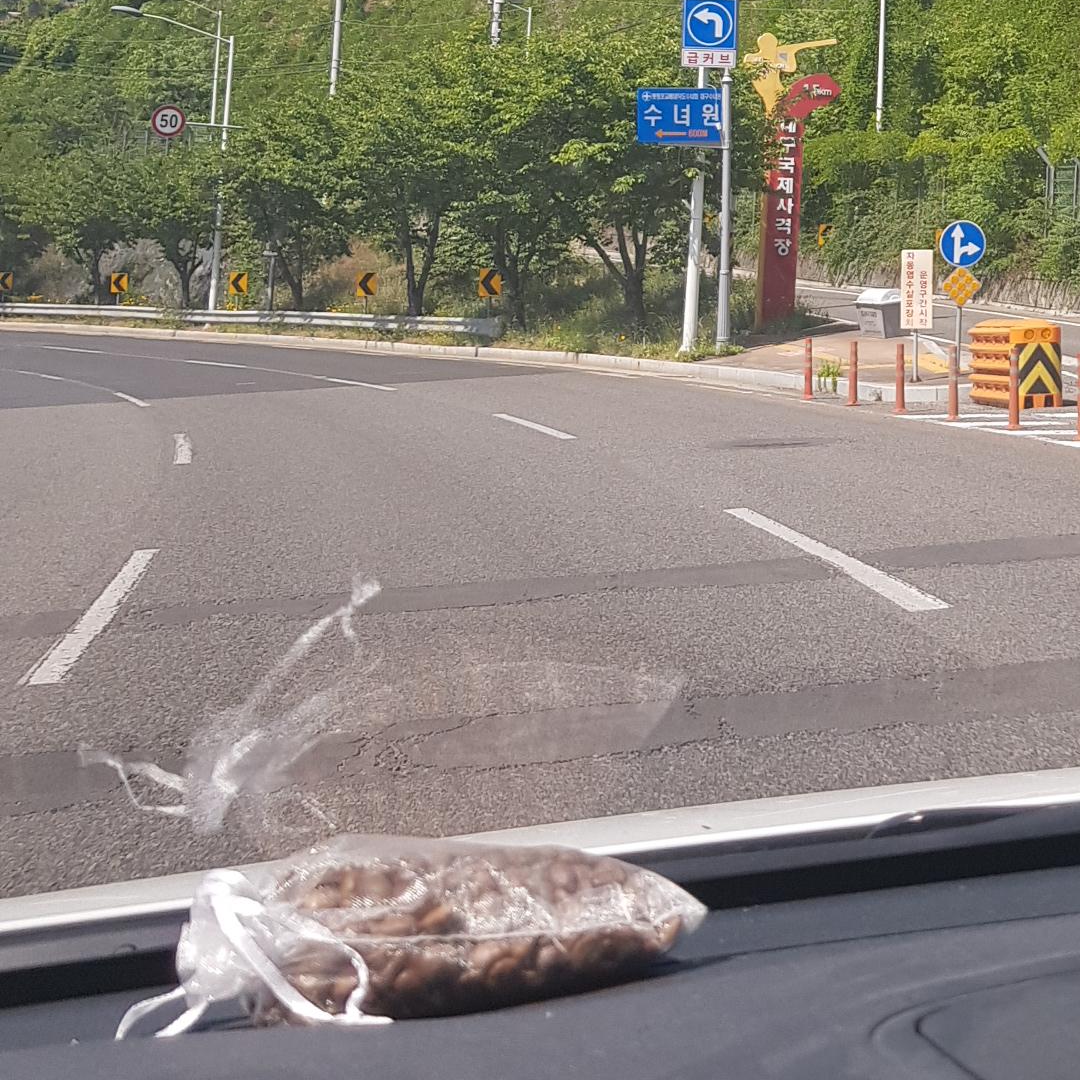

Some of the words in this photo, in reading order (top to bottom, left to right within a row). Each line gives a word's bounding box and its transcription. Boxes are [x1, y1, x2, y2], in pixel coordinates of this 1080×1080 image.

[686, 52, 732, 65] 급커브
[160, 114, 178, 128] 50
[643, 104, 721, 127] 수녀원
